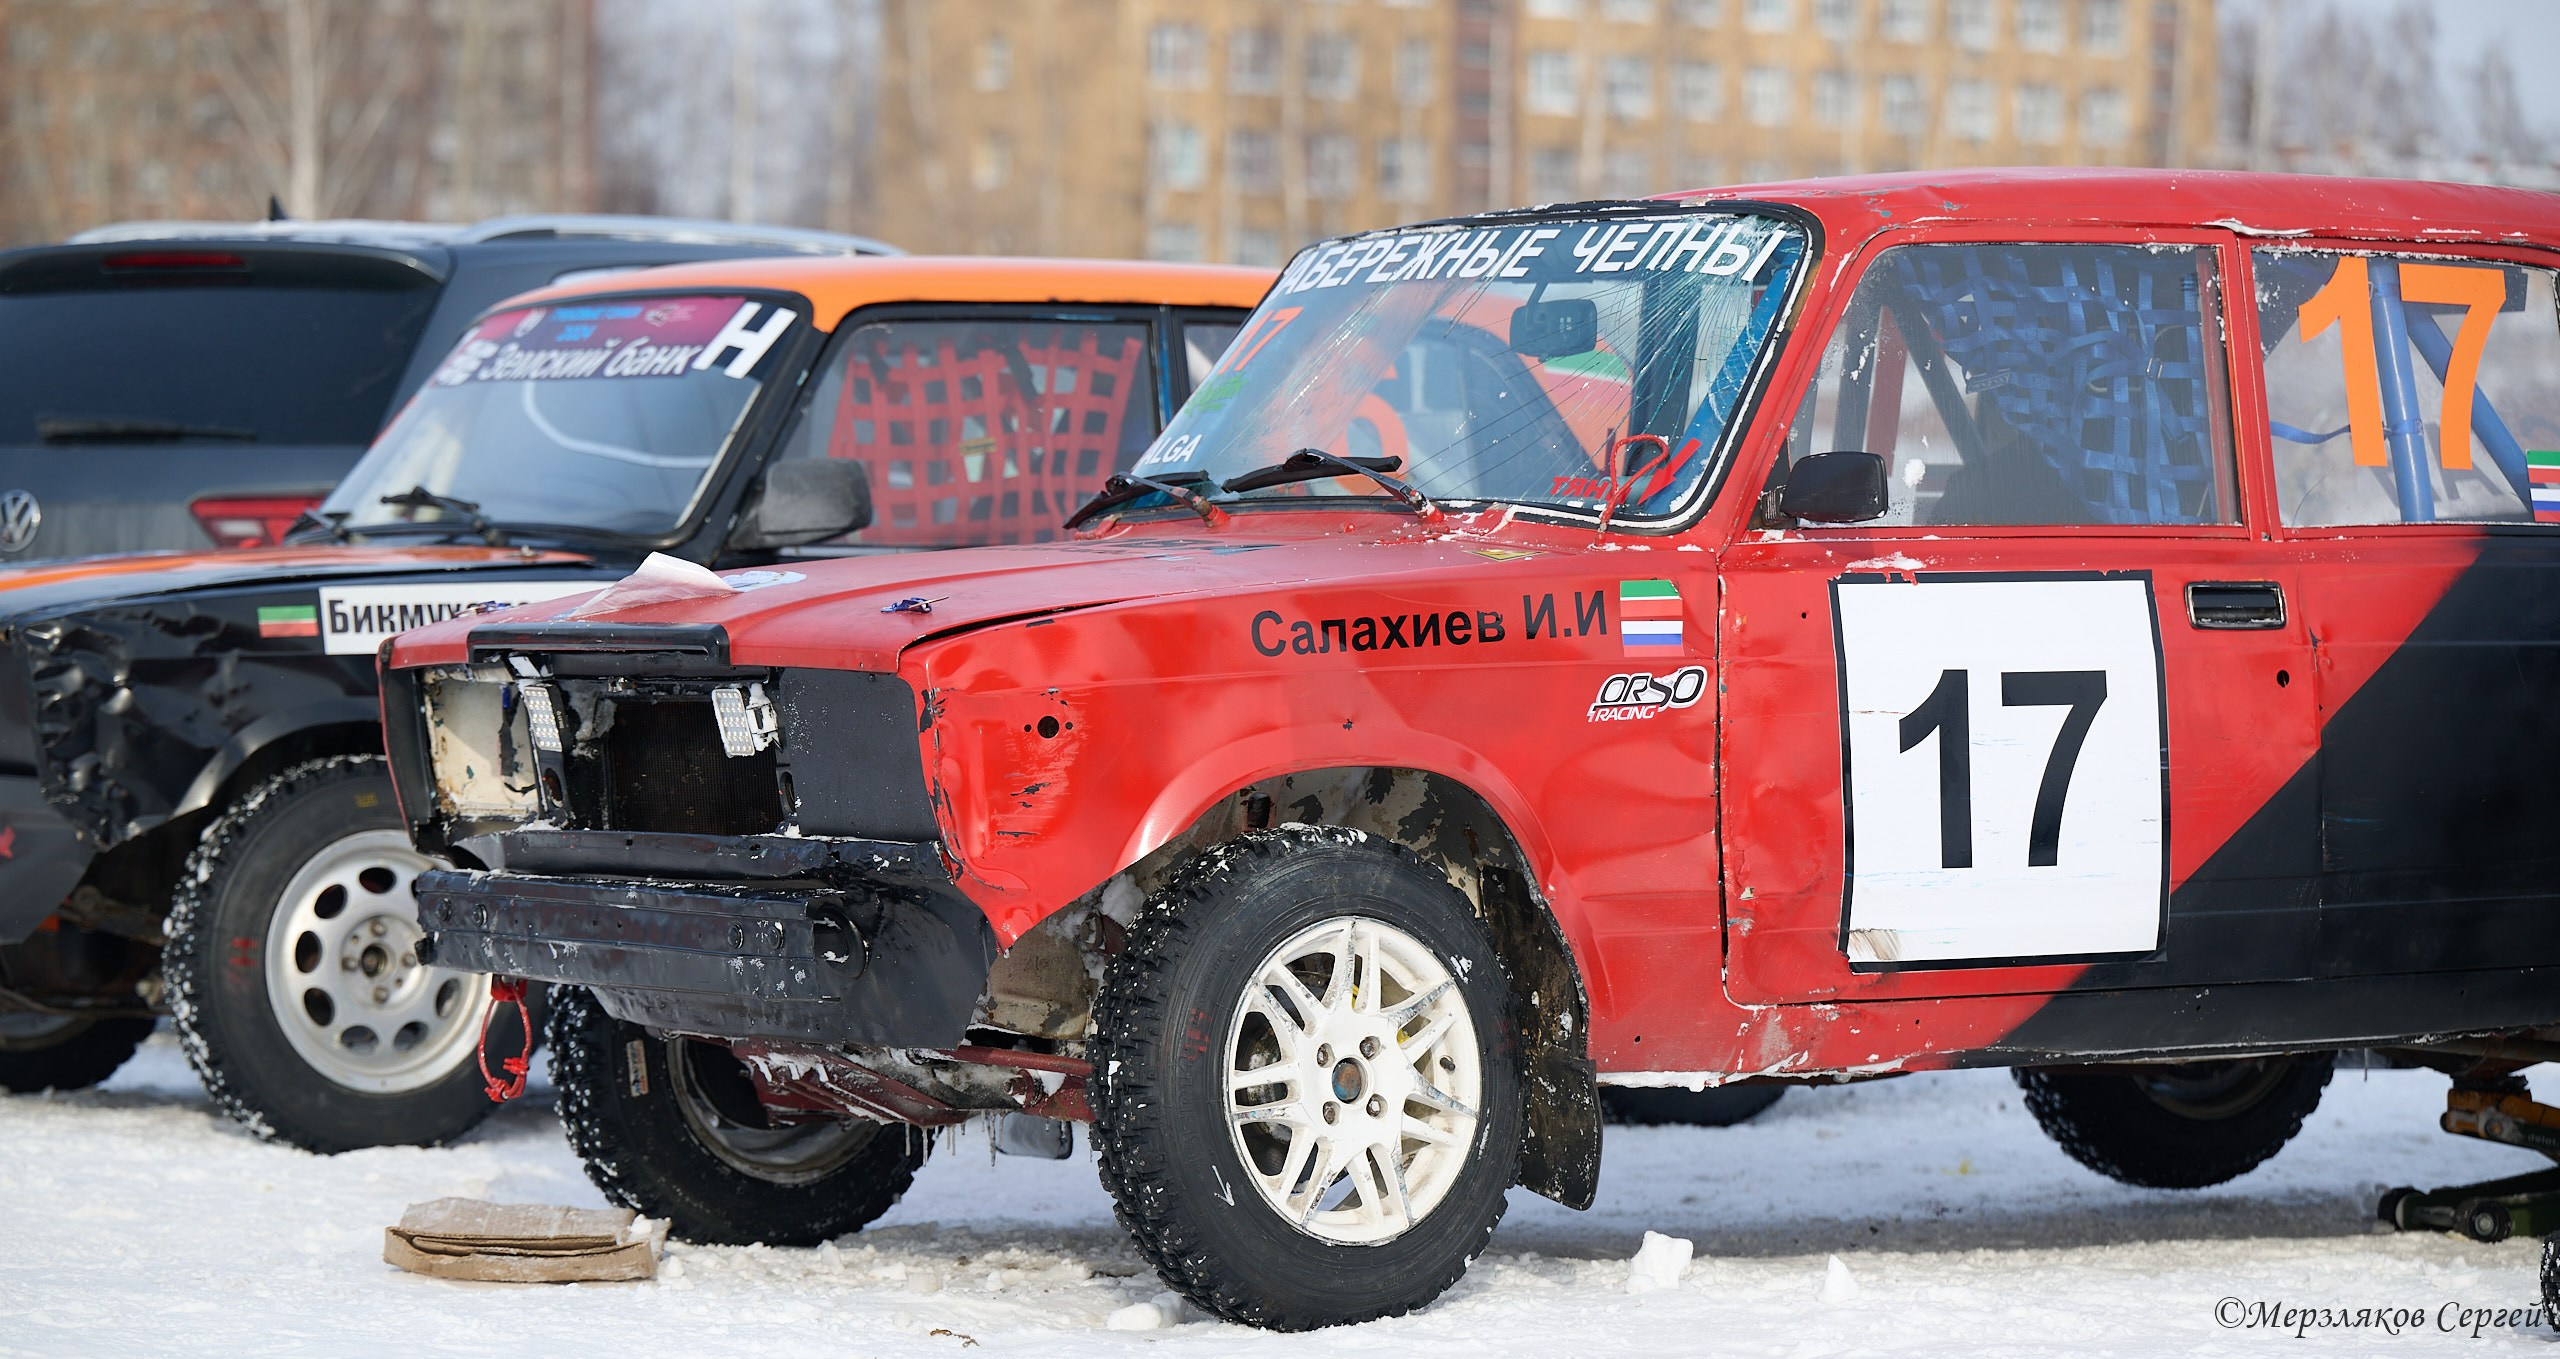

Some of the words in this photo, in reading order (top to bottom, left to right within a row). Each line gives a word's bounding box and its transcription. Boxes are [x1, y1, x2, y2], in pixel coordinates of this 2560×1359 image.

[1573, 223, 1787, 282] ЧЕЛНЫ
[603, 336, 704, 378] банк
[1217, 306, 1304, 375] 17
[2298, 256, 2506, 470] 17
[1251, 610, 1506, 657] Салахиев
[1523, 591, 1608, 640] И.И
[1594, 705, 1657, 722] RACING
[1599, 667, 1706, 708] ORSO
[1899, 669, 2108, 869] 17
